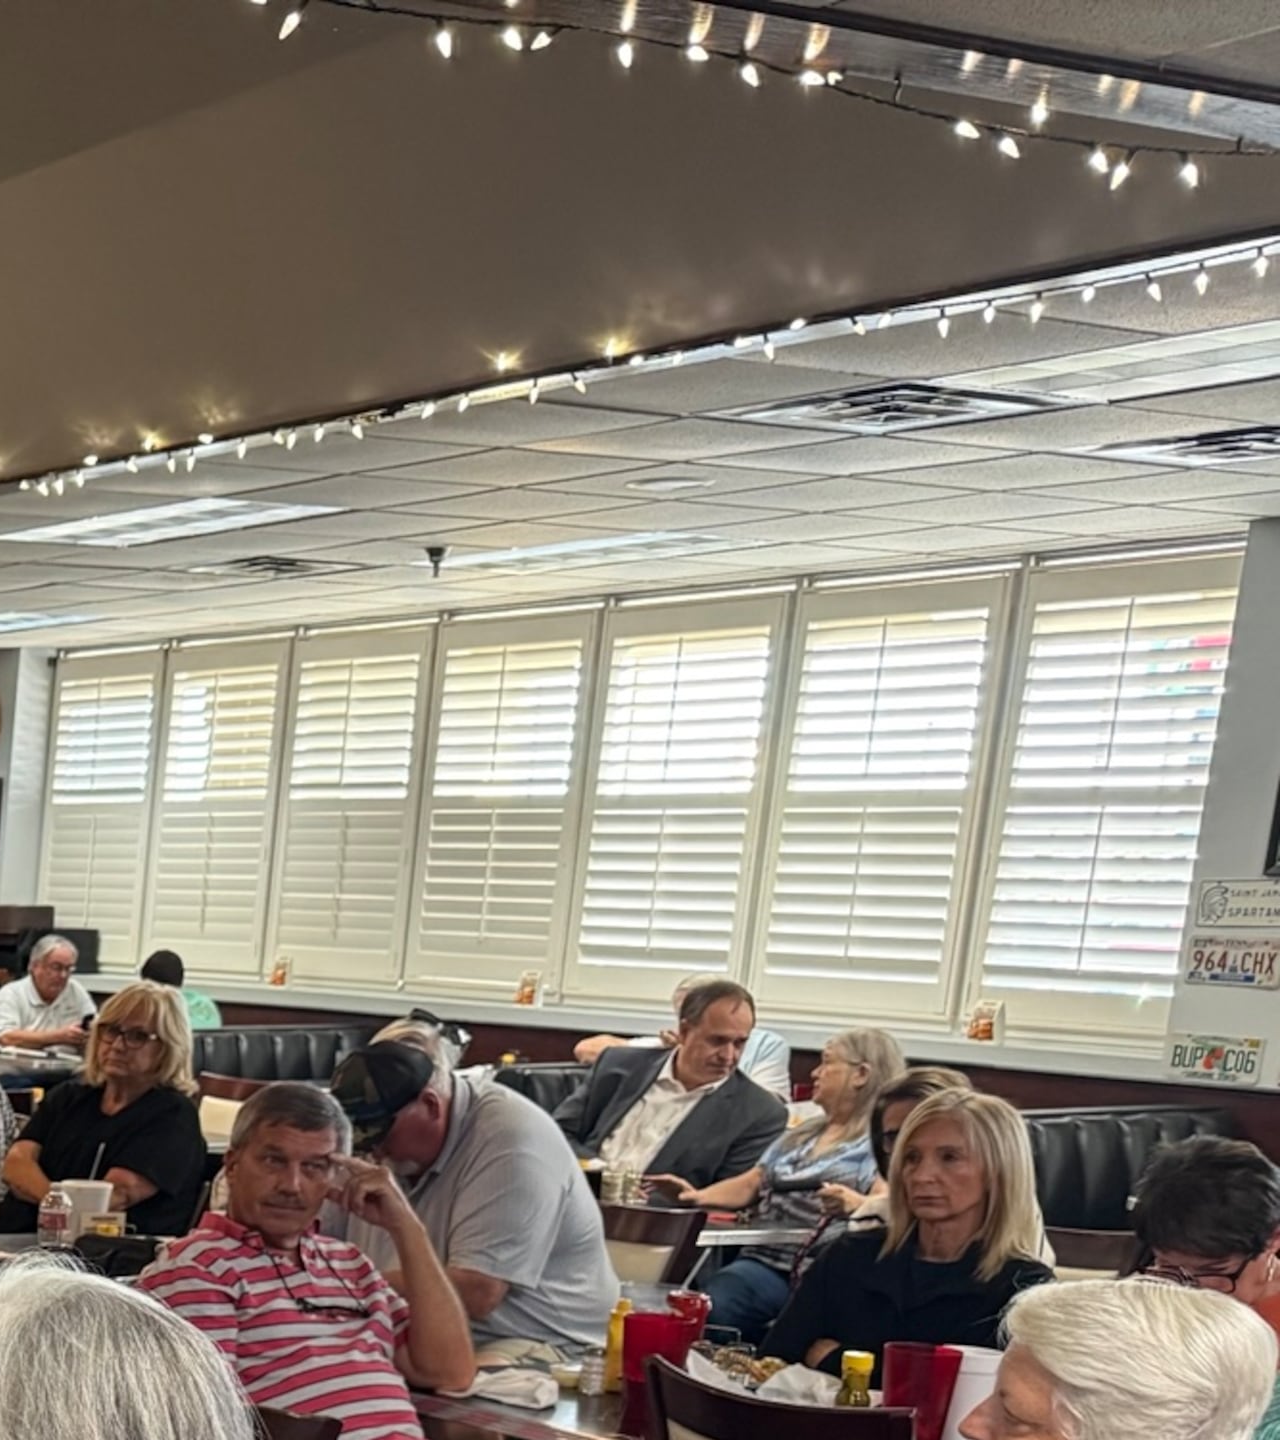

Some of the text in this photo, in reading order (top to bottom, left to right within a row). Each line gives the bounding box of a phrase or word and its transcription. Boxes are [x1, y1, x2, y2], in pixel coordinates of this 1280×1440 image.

[1193, 949, 1278, 975] 964 CHX
[1171, 1044, 1204, 1068] BUP
